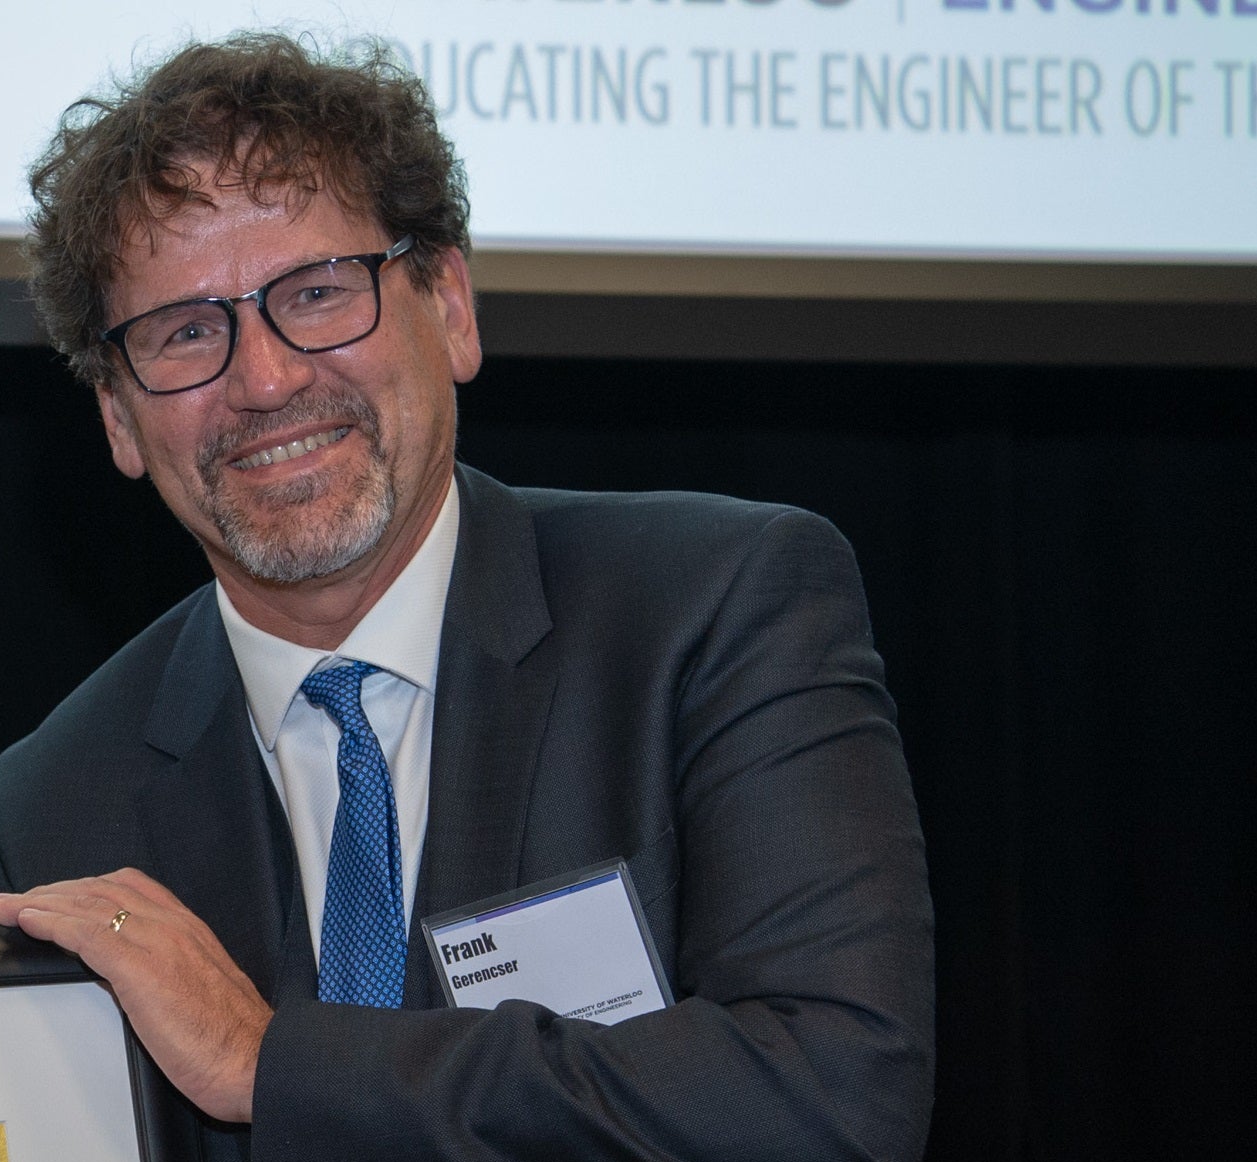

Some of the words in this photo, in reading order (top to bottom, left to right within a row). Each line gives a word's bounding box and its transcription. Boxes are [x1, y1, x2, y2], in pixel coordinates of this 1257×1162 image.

[690, 48, 799, 129] THE
[819, 52, 1104, 137] ENGINEER
[1125, 58, 1195, 138] OF
[441, 932, 498, 964] Frank
[451, 960, 518, 989] Gerencser
[562, 1004, 595, 1018] NIVERSITY
[596, 1001, 606, 1009] OF
[606, 990, 643, 1005] WATERLOO
[594, 1000, 633, 1014] ENGINEERING
